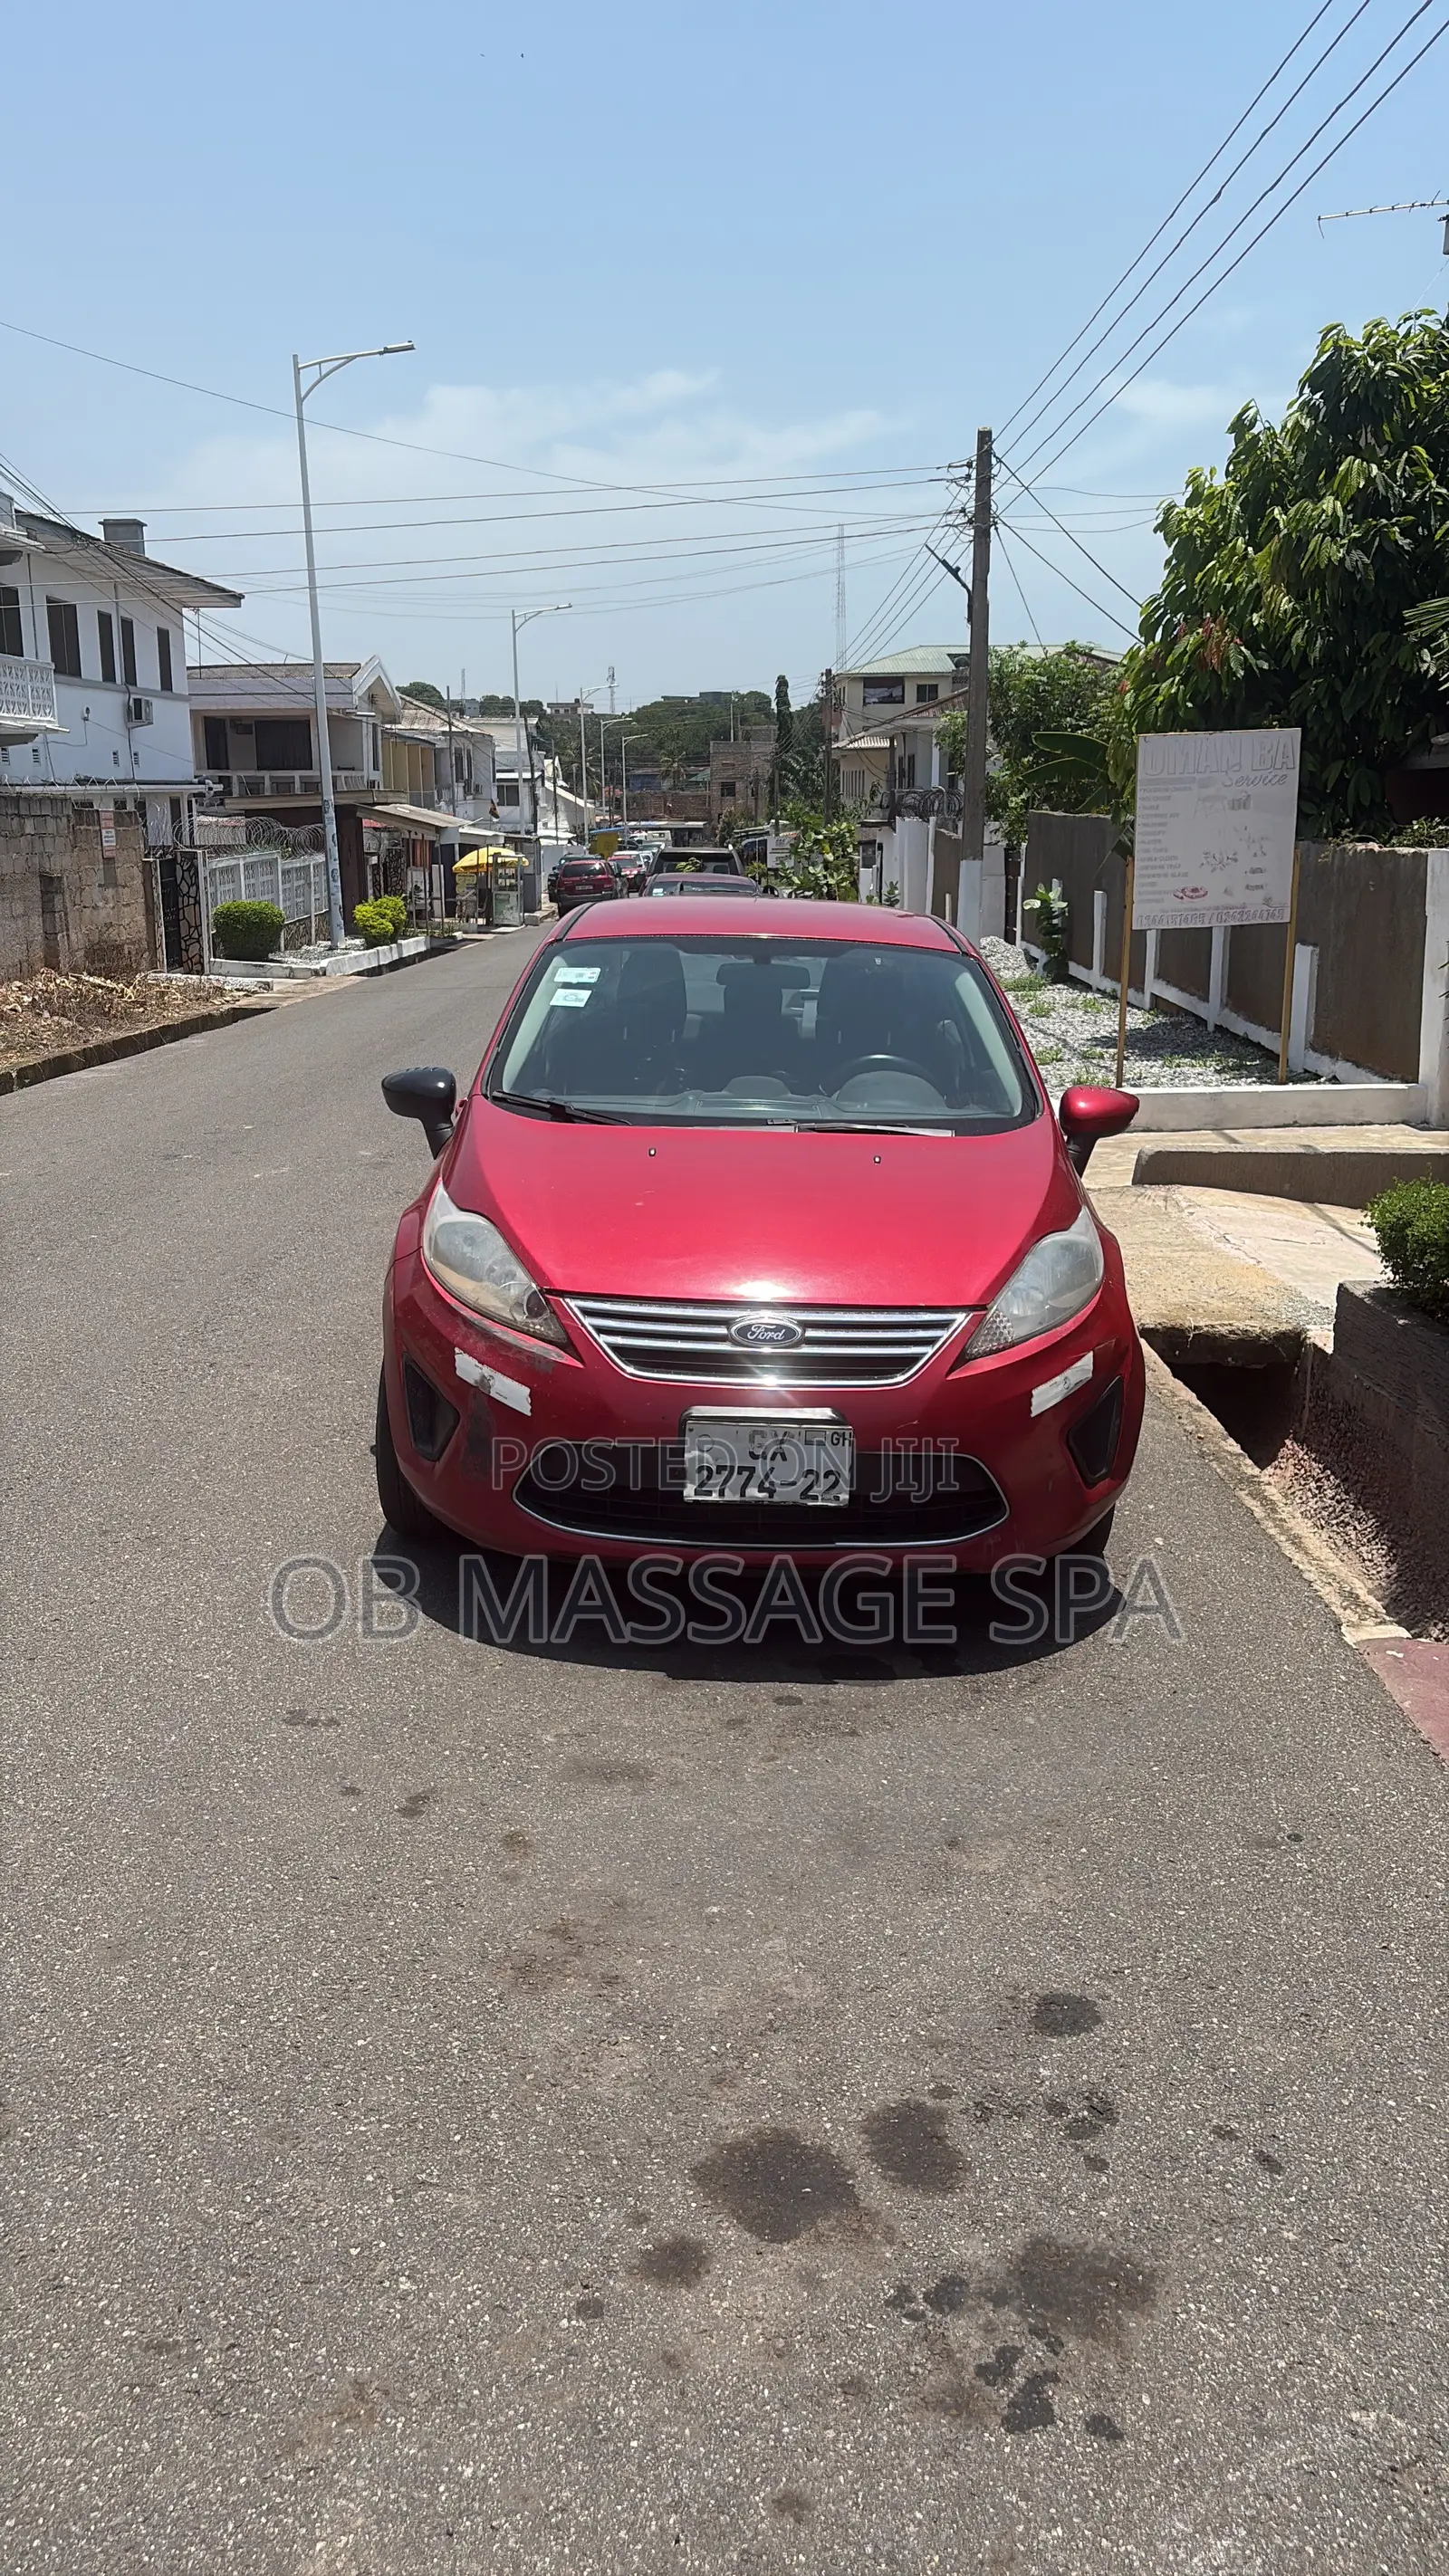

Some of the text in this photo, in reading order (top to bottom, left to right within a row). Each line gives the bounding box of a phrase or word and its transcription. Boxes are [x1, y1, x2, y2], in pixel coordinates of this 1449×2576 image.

[1252, 735, 1297, 771] BA
[1222, 762, 1288, 788] Service
[746, 1324, 785, 1341] Ford
[830, 1431, 852, 1447] GH
[694, 1464, 841, 1501] 2774-22
